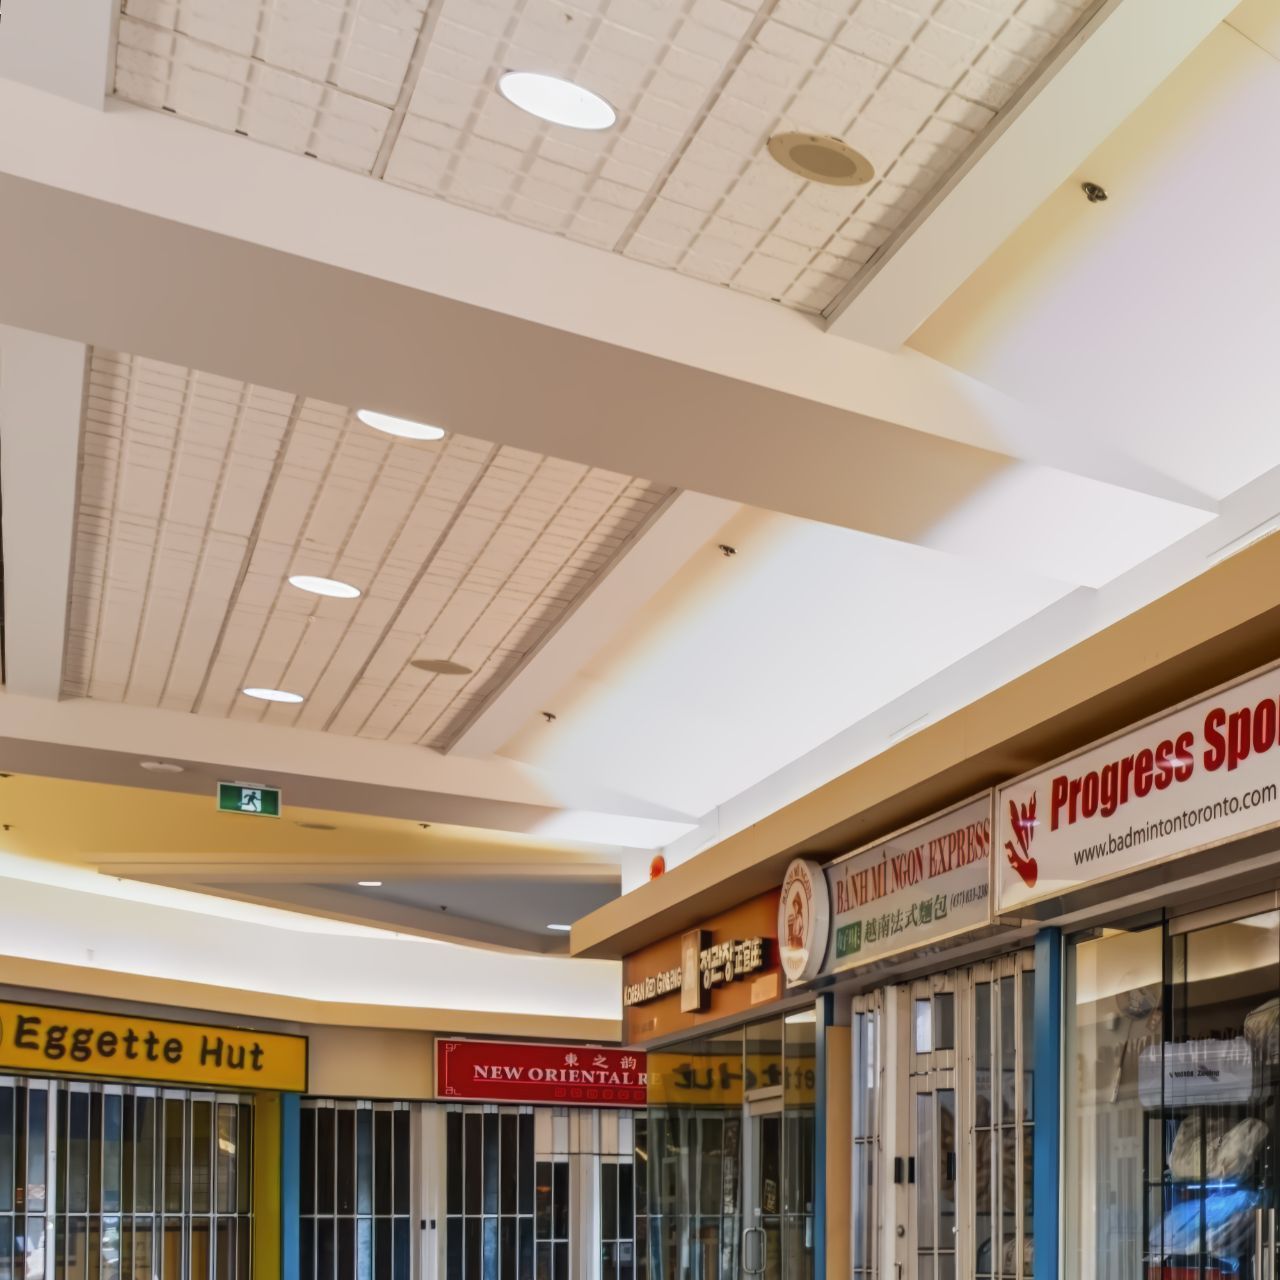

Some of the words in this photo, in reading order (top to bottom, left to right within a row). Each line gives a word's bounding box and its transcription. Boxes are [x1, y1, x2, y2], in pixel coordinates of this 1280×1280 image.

[1050, 731, 1194, 832] Progress
[891, 844, 925, 894] NGON
[928, 817, 990, 880] EXPRESS
[1074, 783, 1278, 866] www.badmintontoronto.com
[13, 1014, 184, 1063] Eggette
[199, 1035, 265, 1071] Hut
[473, 1064, 525, 1081] NEW
[528, 1068, 634, 1085] ORIENTAL
